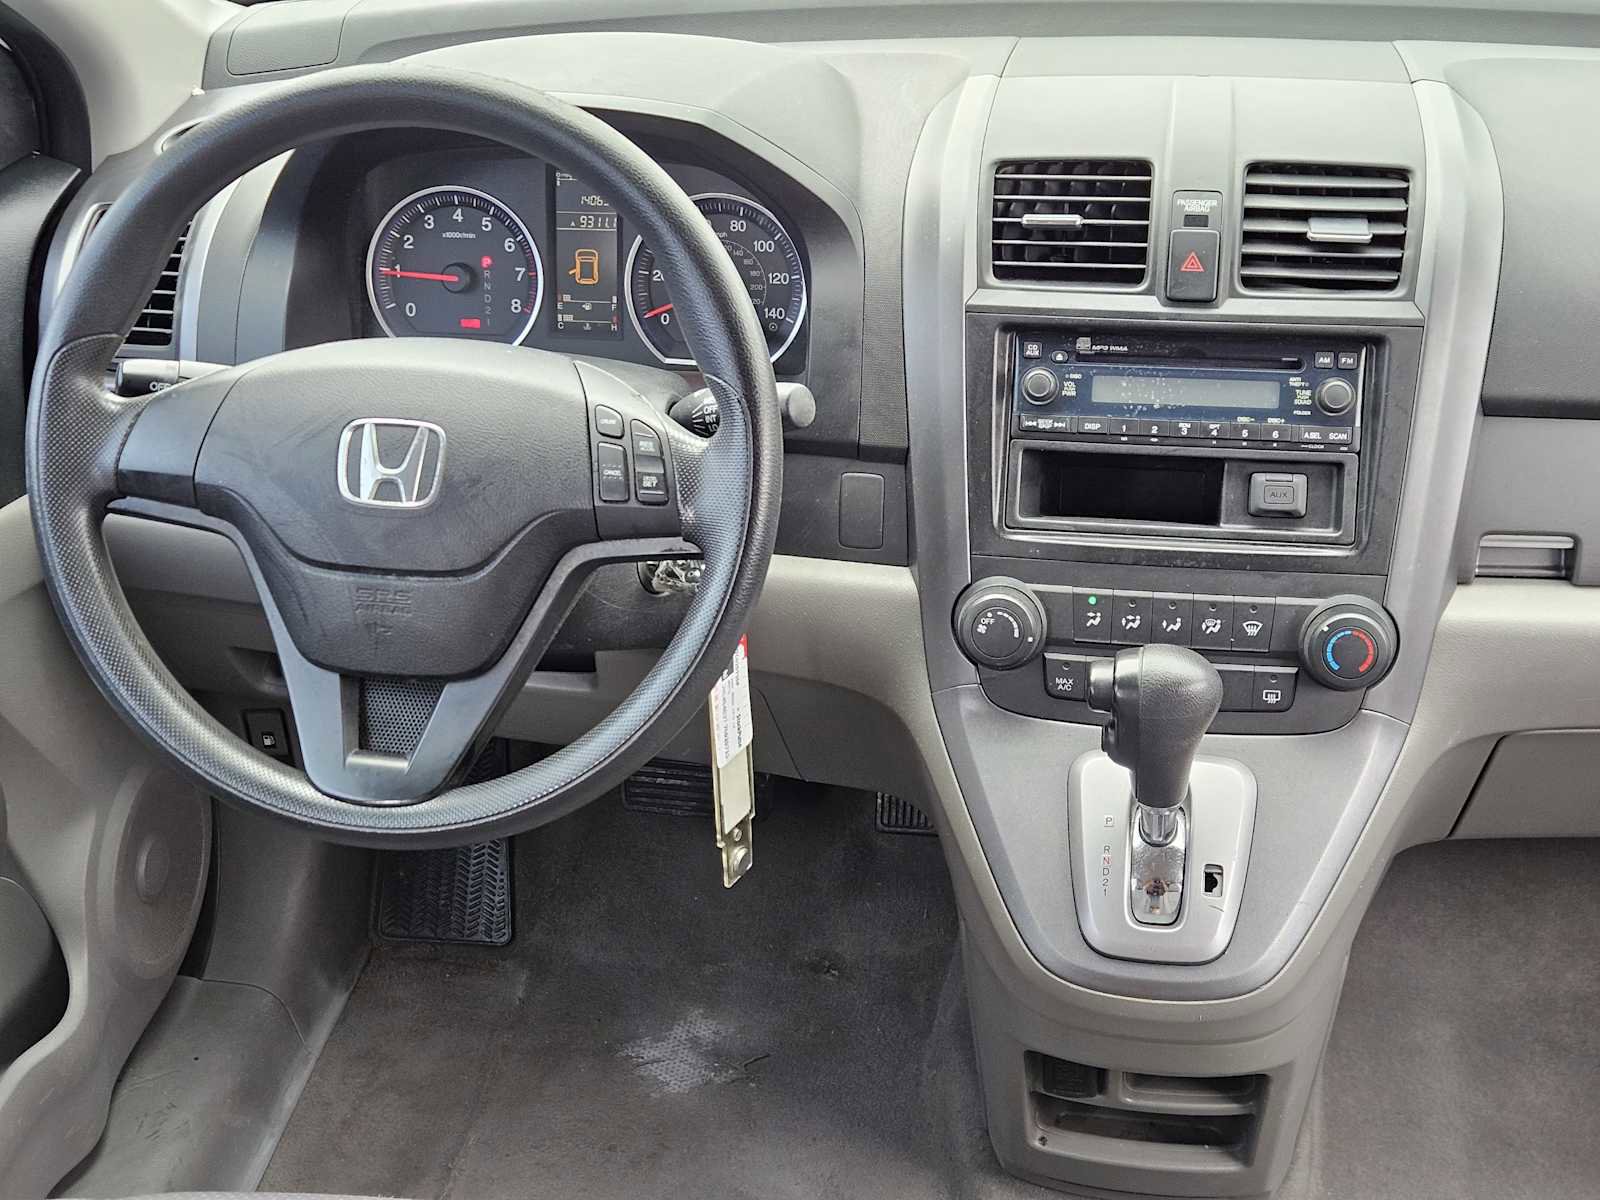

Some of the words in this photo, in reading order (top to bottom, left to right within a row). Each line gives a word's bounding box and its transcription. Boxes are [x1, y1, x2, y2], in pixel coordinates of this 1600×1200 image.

[581, 195, 609, 206] 1406
[453, 208, 463, 222] 4
[424, 215, 434, 229] 3
[481, 217, 492, 231] 5
[730, 220, 747, 232] 80
[403, 235, 414, 249] 2
[504, 238, 515, 252] 6
[753, 240, 775, 252] 100
[484, 270, 490, 279] R
[515, 267, 525, 281] 7
[768, 273, 789, 284] 120
[484, 282, 491, 290] N
[484, 294, 491, 303] D
[405, 303, 416, 317] 0
[485, 306, 492, 315] 2
[511, 299, 521, 313] 8
[557, 302, 563, 310] E
[611, 303, 617, 311] F
[764, 307, 785, 319] 140
[660, 314, 670, 325] 0
[557, 321, 564, 329] C
[611, 323, 617, 331] H
[704, 404, 718, 414] OFF
[705, 414, 717, 424] INT
[1121, 424, 1127, 433] 1
[1151, 425, 1158, 434] 2
[1181, 427, 1188, 435] 3
[1241, 429, 1248, 438] 5
[1272, 430, 1279, 439] 6
[1329, 432, 1347, 440] SCAN
[1055, 677, 1073, 685] MAX
[1103, 857, 1110, 865] N
[1102, 868, 1109, 876] D
